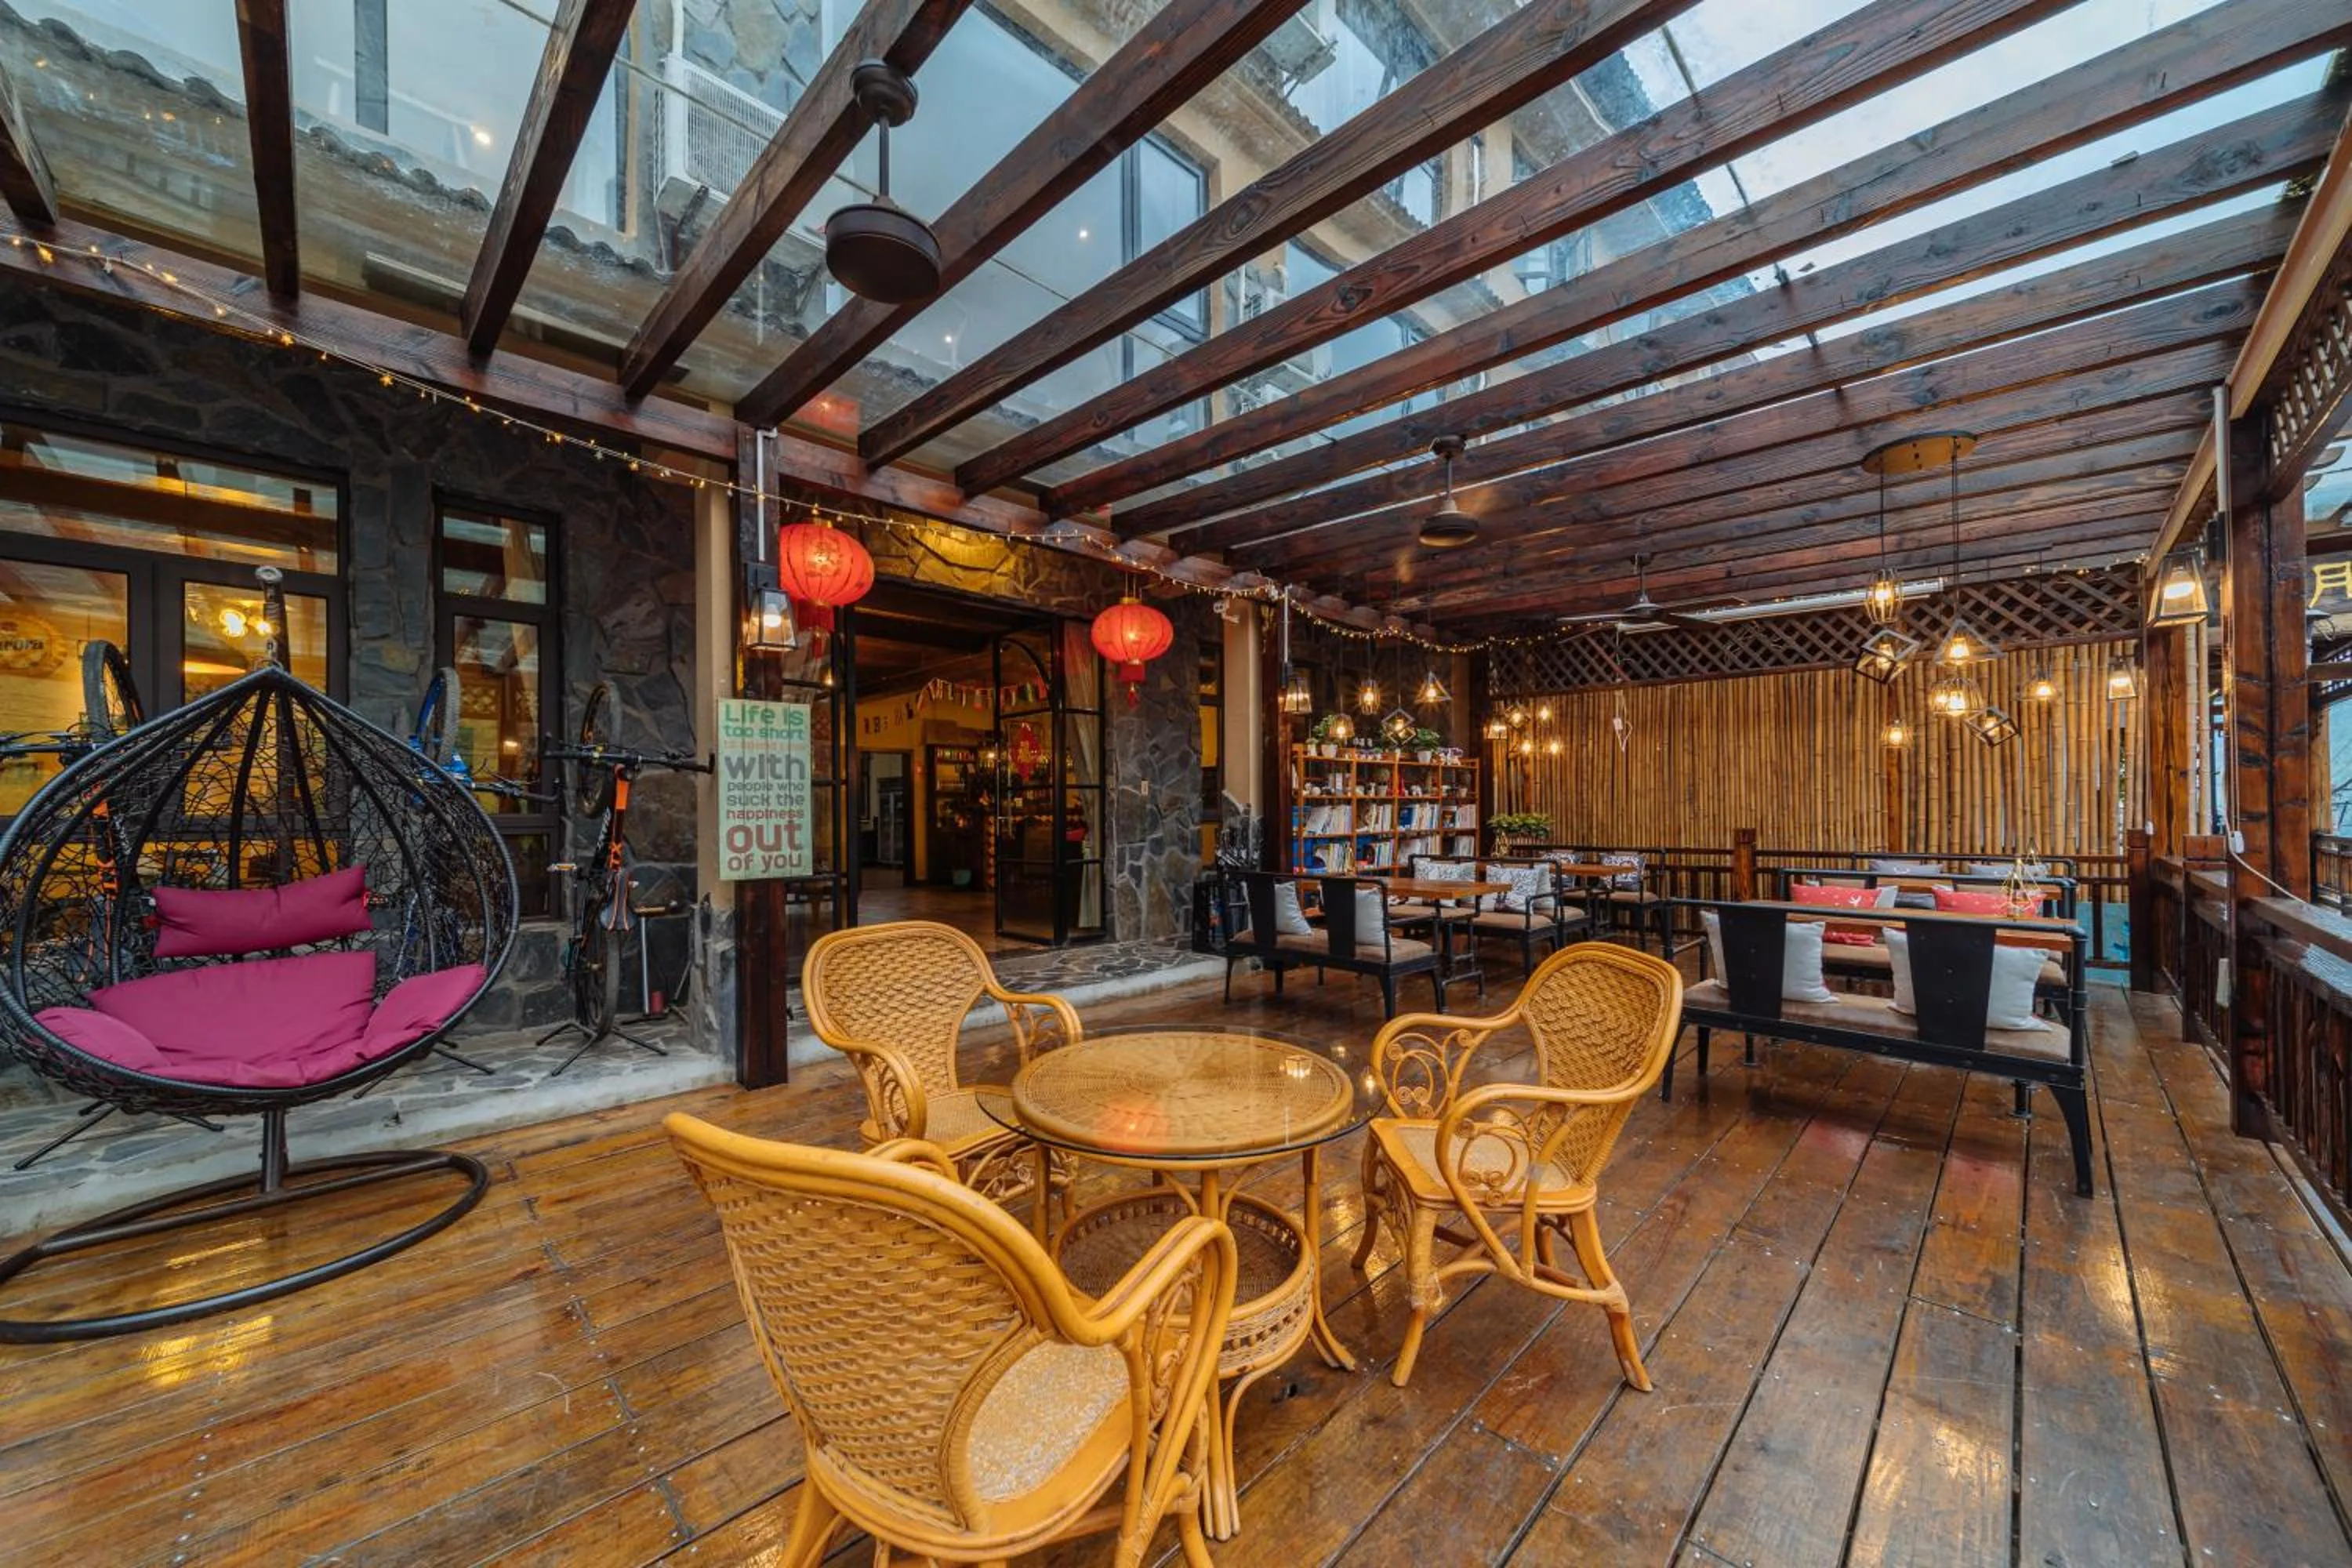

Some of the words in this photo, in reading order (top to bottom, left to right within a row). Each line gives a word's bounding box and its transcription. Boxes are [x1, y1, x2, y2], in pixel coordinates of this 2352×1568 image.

[724, 702, 775, 724] Life
[782, 707, 804, 726] is
[724, 724, 754, 737] too
[758, 727, 804, 740] short
[724, 753, 807, 780] with
[727, 782, 773, 793] people
[777, 782, 804, 792] who
[727, 793, 771, 807] suck
[776, 793, 804, 807] the
[727, 808, 804, 821] happiness
[726, 819, 803, 854] out
[727, 853, 754, 872] of
[760, 852, 803, 874] you
